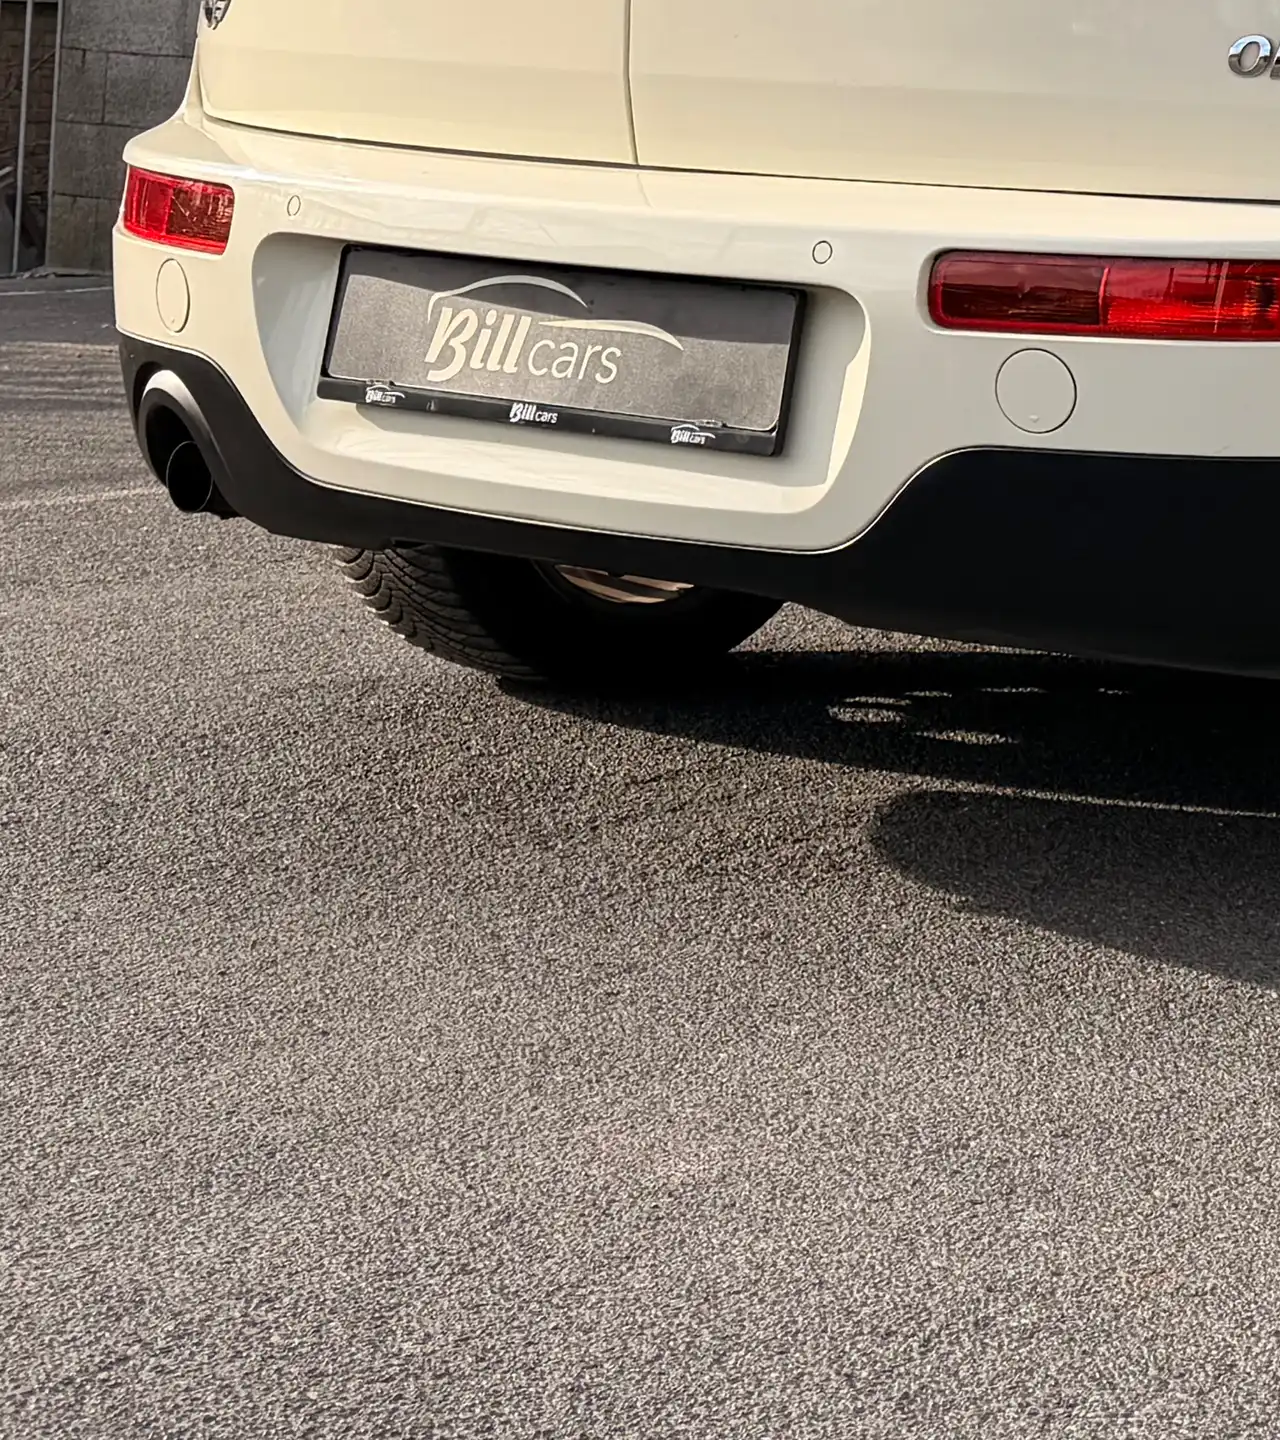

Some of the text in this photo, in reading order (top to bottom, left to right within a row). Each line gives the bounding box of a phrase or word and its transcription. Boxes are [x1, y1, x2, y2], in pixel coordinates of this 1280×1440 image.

[425, 306, 621, 384] Bill cars
[509, 402, 558, 424] Bill cars
